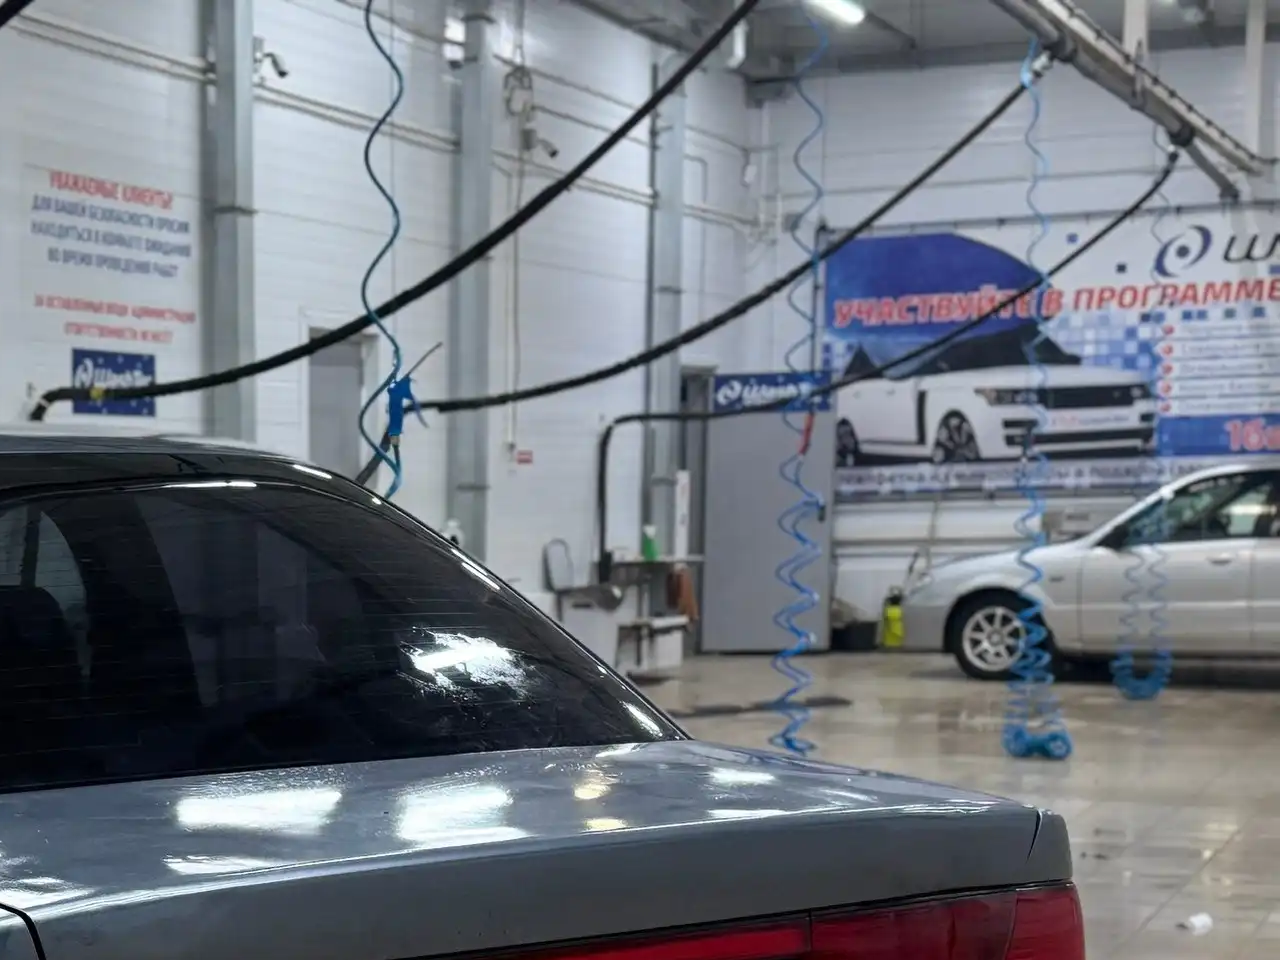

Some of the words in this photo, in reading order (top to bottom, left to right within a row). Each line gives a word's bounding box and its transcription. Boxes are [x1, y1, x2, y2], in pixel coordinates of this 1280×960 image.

[834, 284, 1033, 327] УЧАСТВУЙТЕ
[1042, 287, 1064, 316] В
[1073, 277, 1280, 311] ПРОГРАММЕ
